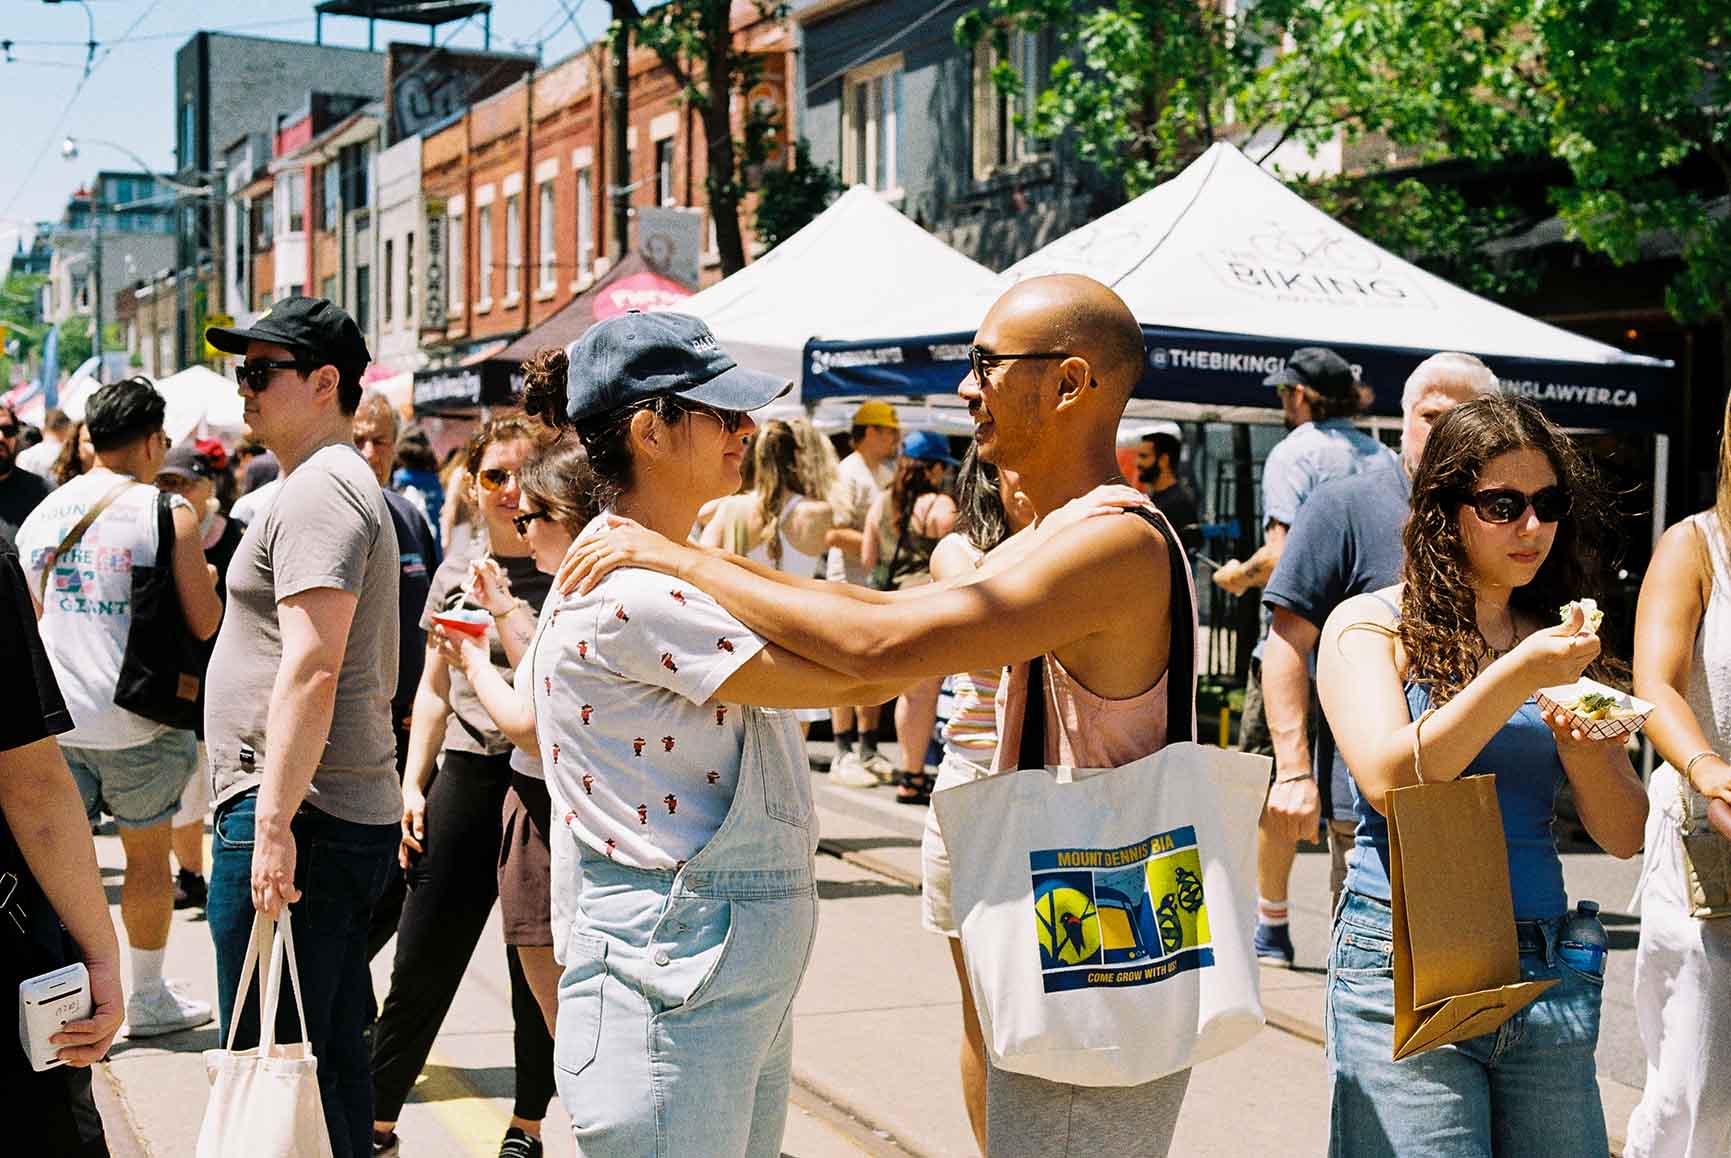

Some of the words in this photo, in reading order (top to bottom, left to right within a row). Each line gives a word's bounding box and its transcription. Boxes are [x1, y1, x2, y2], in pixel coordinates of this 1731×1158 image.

[1228, 262, 1407, 298] BIKING
[1057, 851, 1100, 867] MOUNT
[1104, 844, 1149, 866] DENNIS
[1150, 834, 1175, 854] BIA
[1087, 969, 1114, 983] COME
[1116, 971, 1142, 982] GROW
[1144, 965, 1167, 979] WITH
